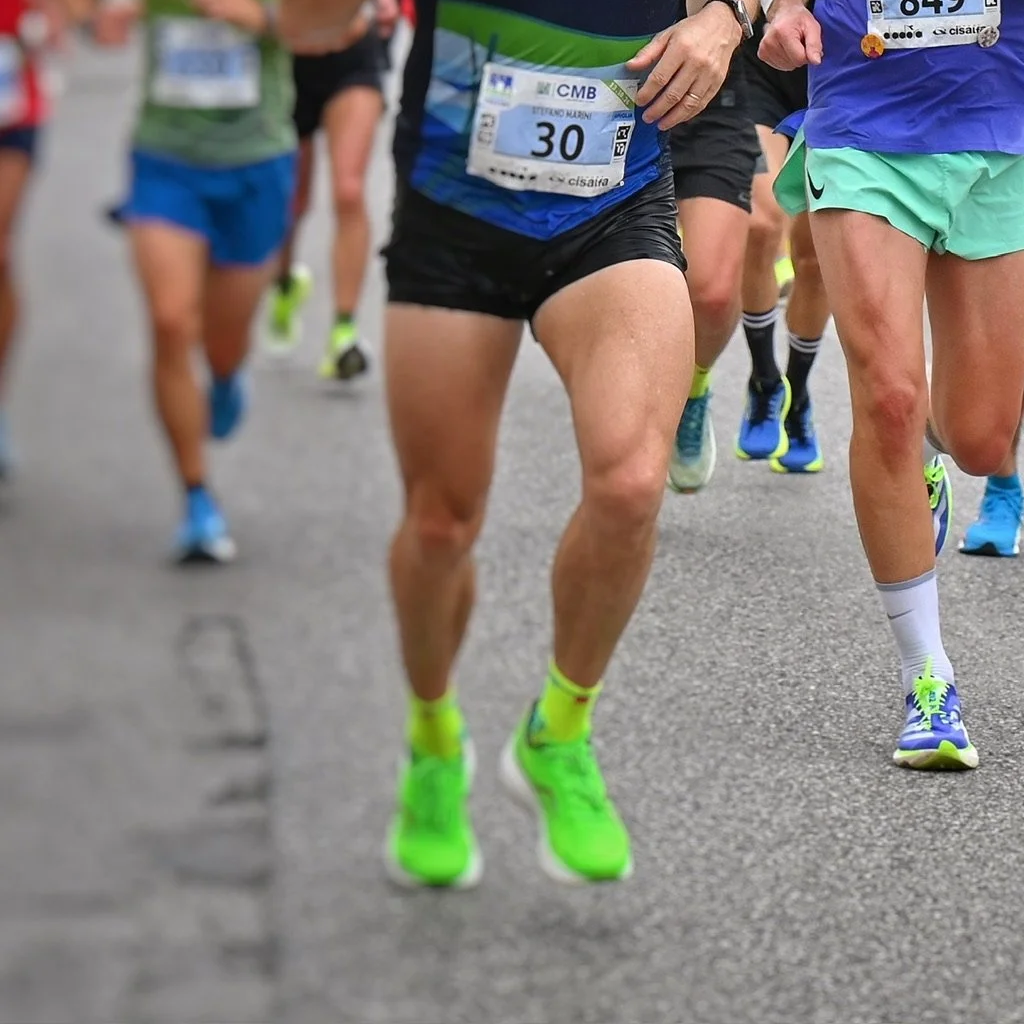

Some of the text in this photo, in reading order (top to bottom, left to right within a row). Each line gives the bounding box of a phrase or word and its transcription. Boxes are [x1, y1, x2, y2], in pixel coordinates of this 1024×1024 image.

[557, 84, 597, 100] CMB
[566, 108, 593, 120] MARINI
[531, 122, 584, 160] 30
